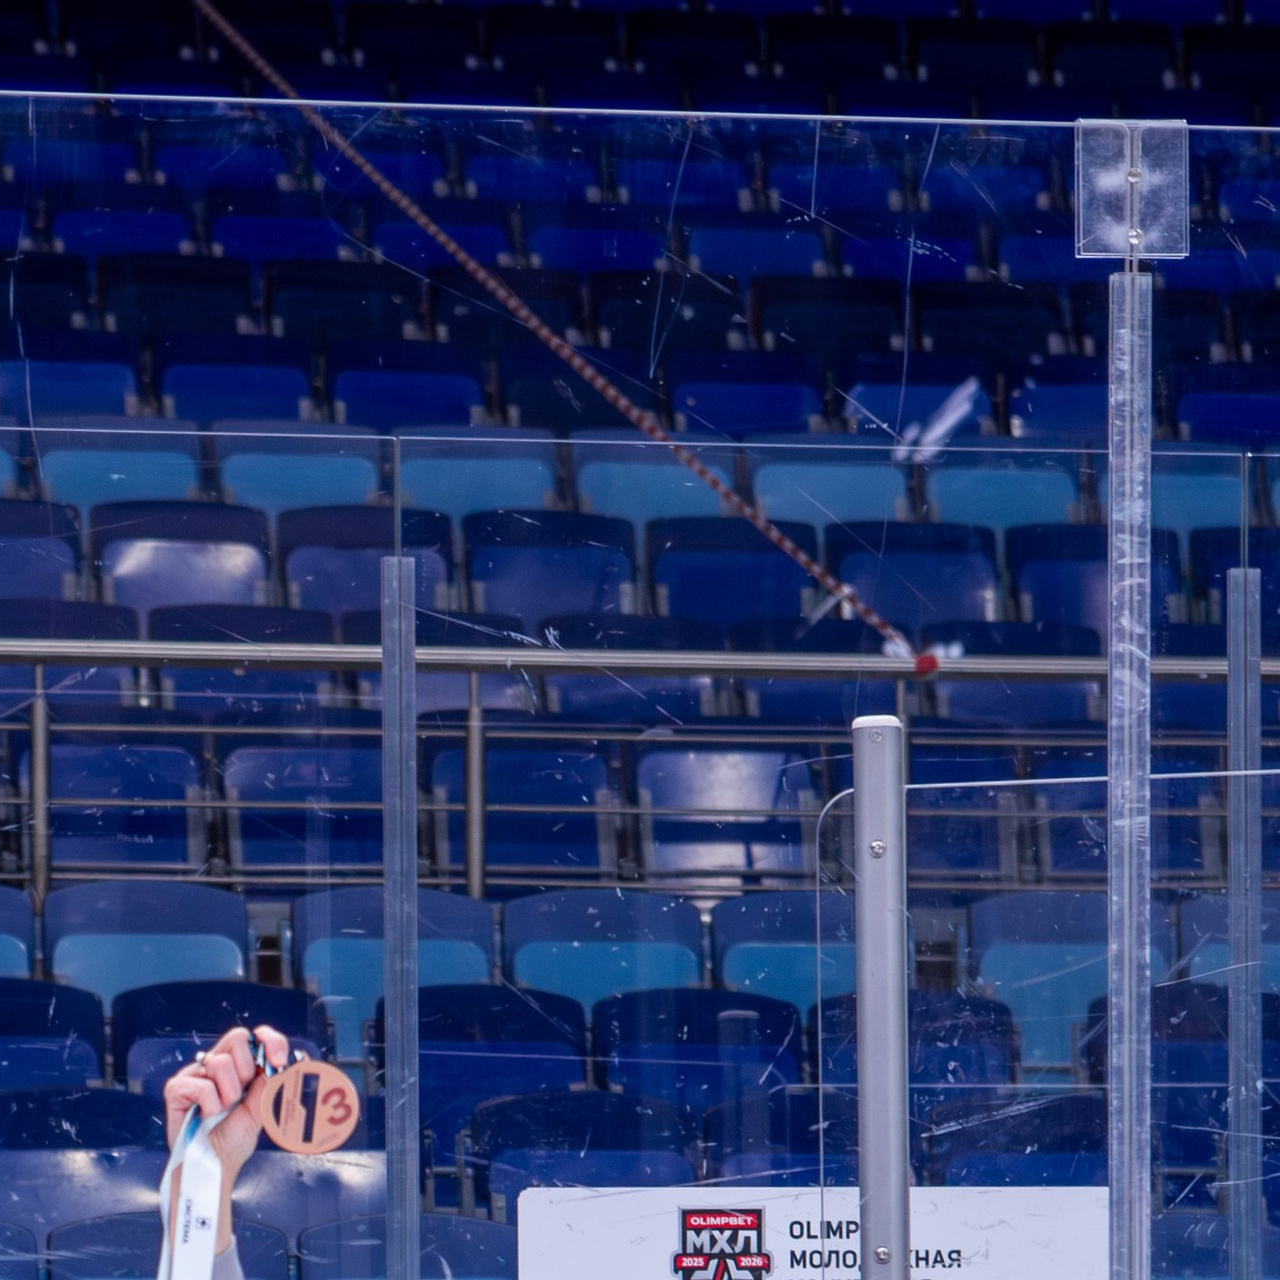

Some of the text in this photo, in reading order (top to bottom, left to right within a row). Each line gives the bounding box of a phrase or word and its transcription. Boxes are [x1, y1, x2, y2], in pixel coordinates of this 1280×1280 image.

[321, 1087, 352, 1126] 3
[690, 1216, 753, 1226] OLIMPBET
[789, 1220, 861, 1239] OLIMP
[686, 1230, 758, 1254] МХЛ
[681, 1257, 764, 1267] 2025 2026
[789, 1250, 962, 1270] МОЛОНАЯ
